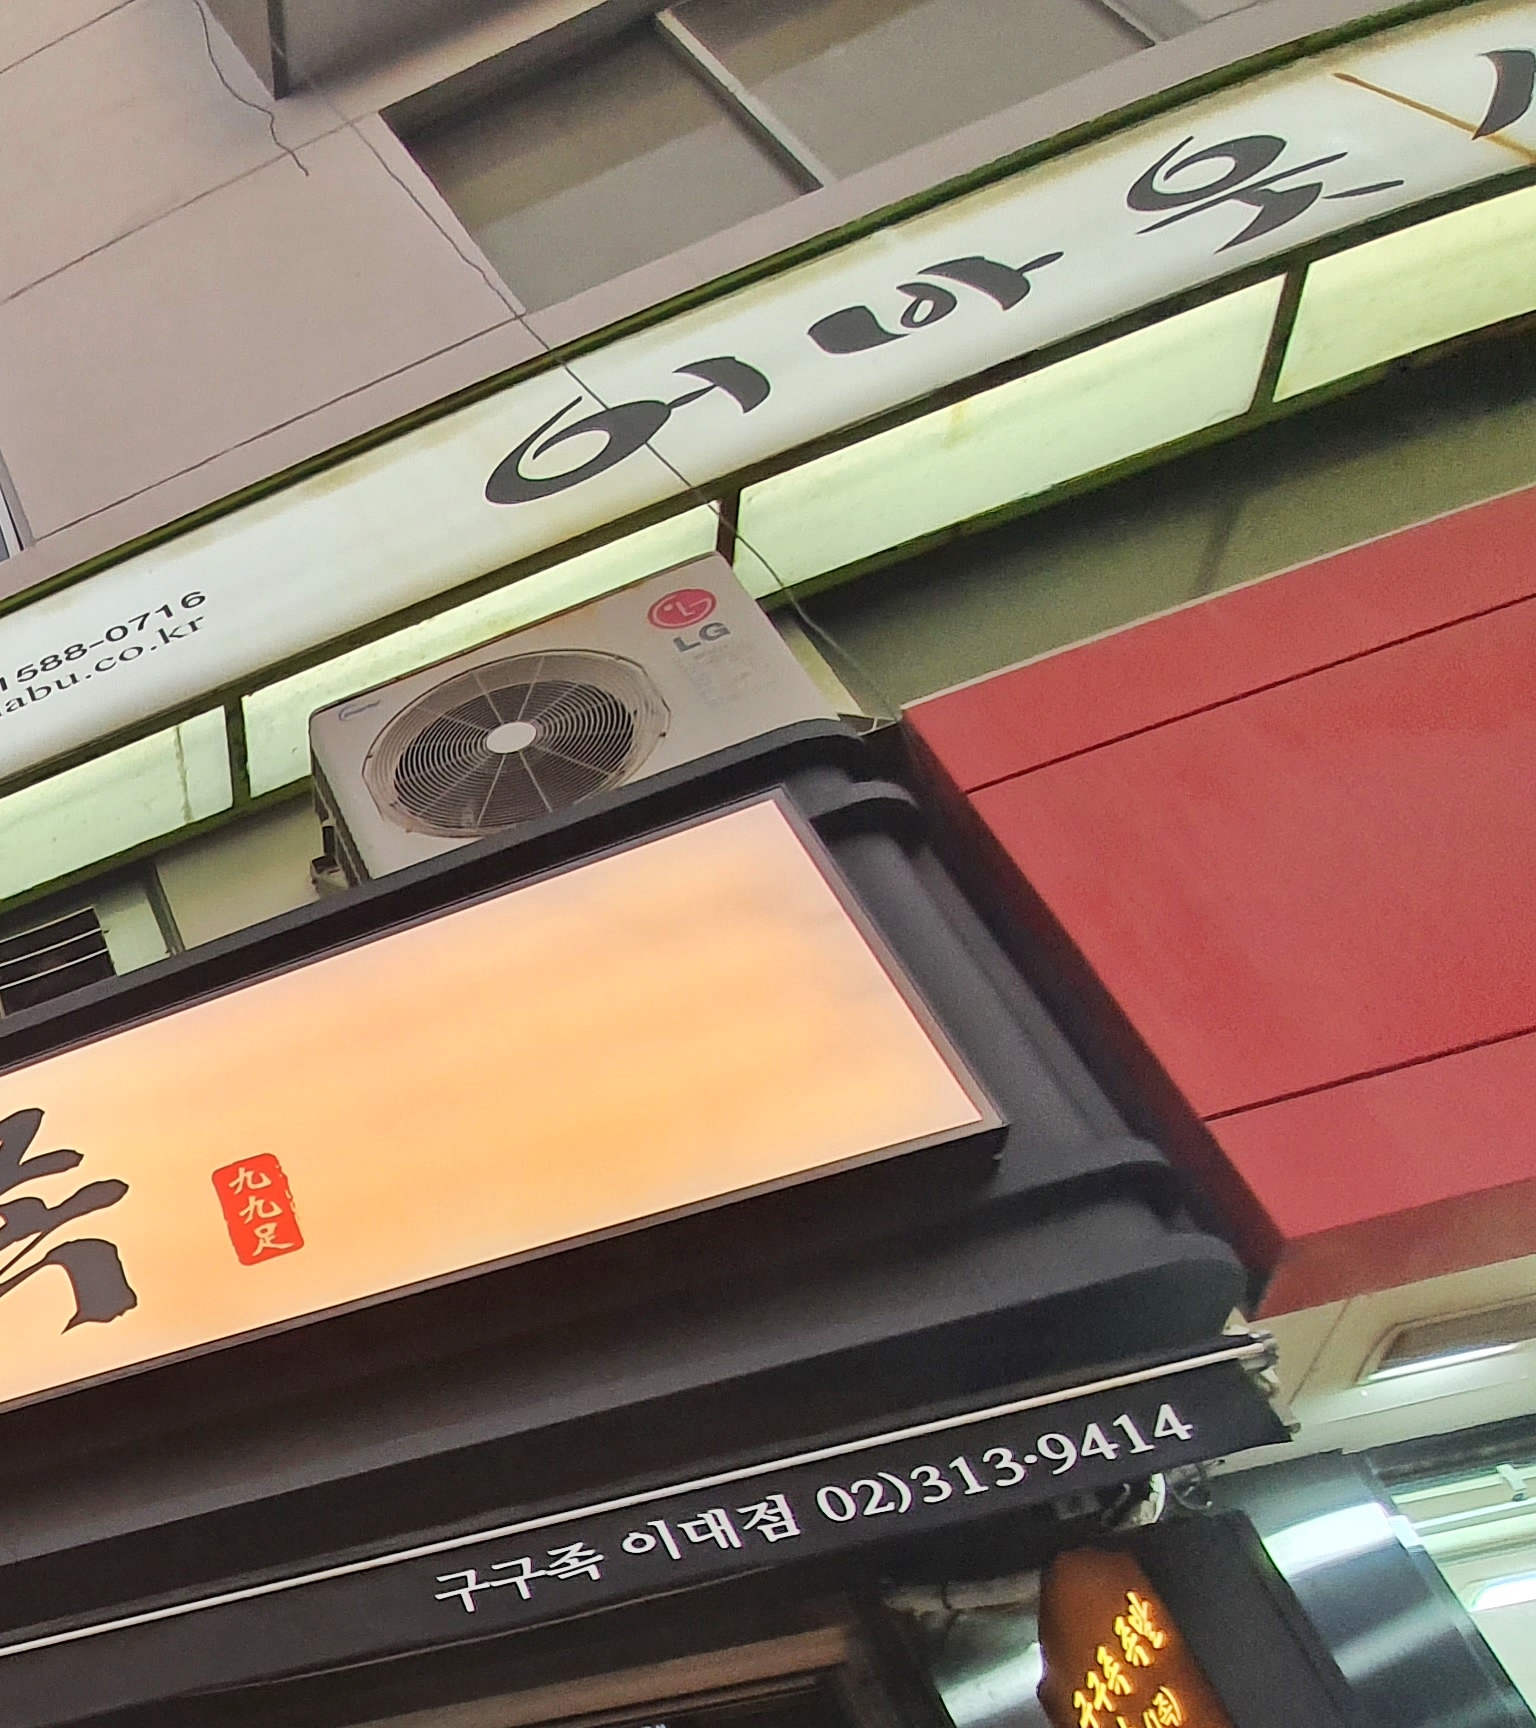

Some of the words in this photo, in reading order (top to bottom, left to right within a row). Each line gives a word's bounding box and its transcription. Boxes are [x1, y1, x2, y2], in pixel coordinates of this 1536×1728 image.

[673, 622, 731, 652] LG
[228, 1167, 295, 1257] 九九足
[434, 1541, 605, 1616] 구구족
[622, 1493, 802, 1561] 이대점
[1113, 1590, 1166, 1667] 족발
